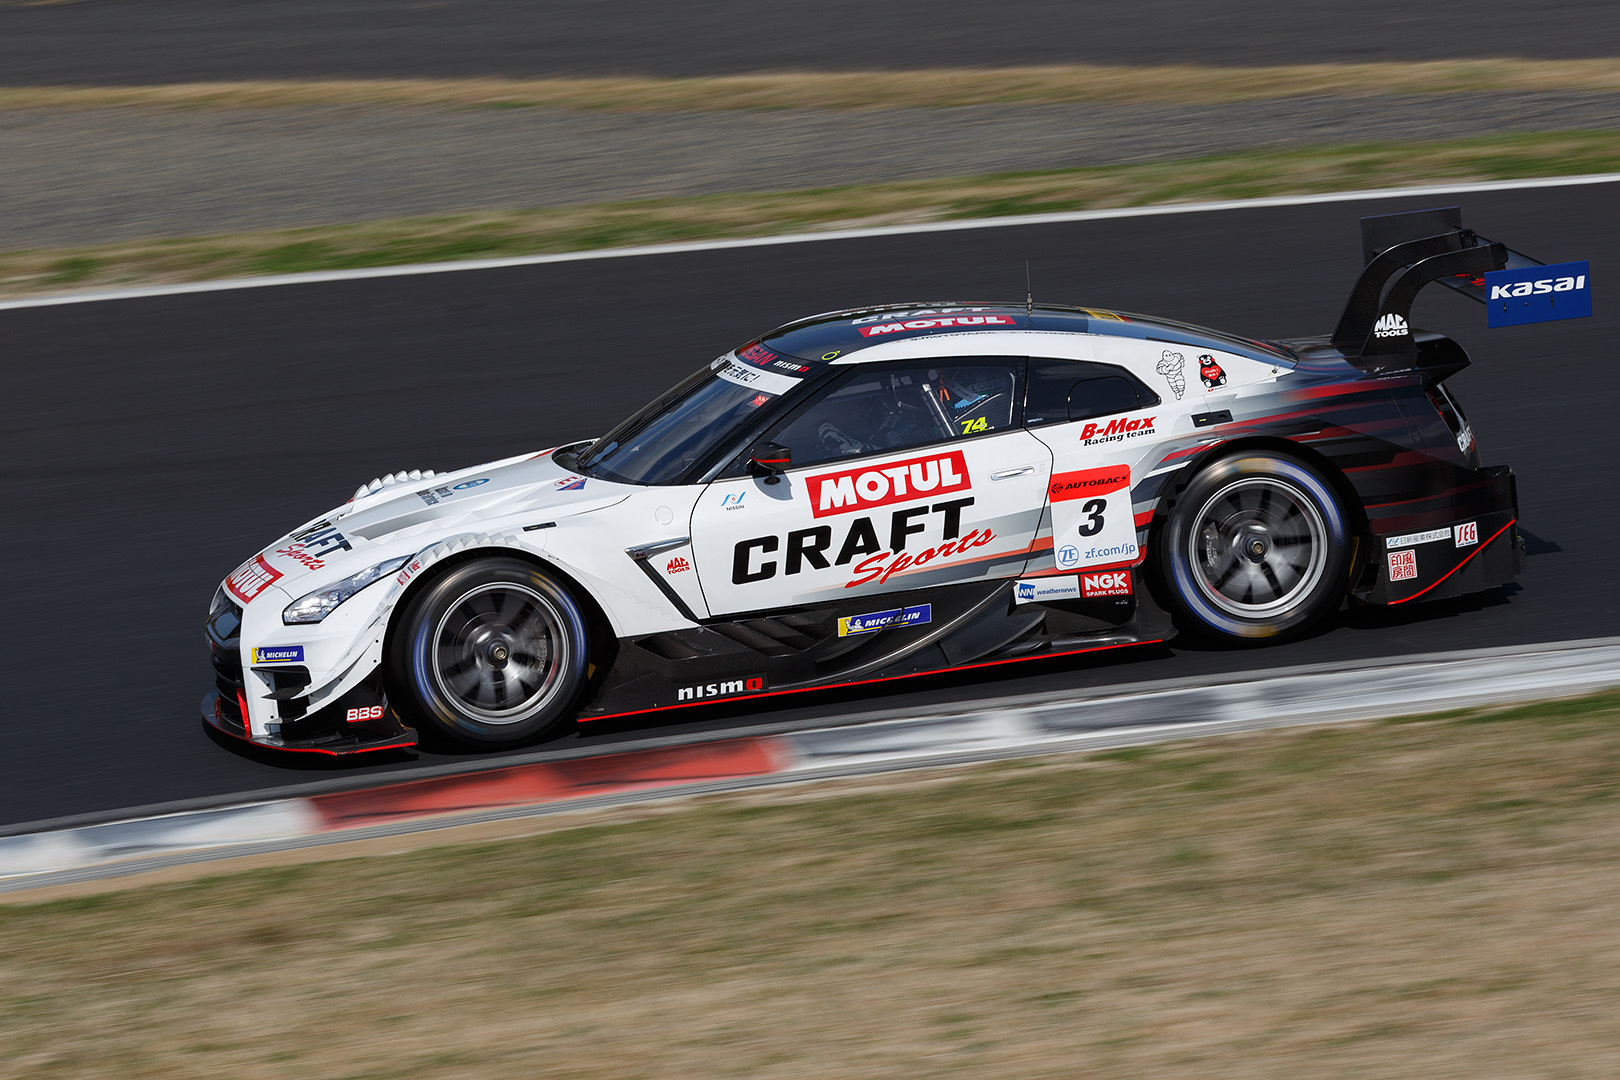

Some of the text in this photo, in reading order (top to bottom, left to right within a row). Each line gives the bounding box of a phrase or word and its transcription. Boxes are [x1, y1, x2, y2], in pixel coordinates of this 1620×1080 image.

[850, 305, 992, 325] CRAFT
[1374, 313, 1408, 332] MAC
[868, 315, 1006, 336] MOTUL
[1374, 328, 1409, 339] TOOLS
[960, 416, 989, 435] 74
[1079, 415, 1158, 441] B-Max
[1083, 427, 1156, 447] Racing team
[819, 456, 964, 512] MOTUL
[1064, 475, 1128, 491] AUTOBACS
[1078, 498, 1108, 537] 3
[731, 496, 975, 586] CRAFT
[276, 543, 326, 571] Sports
[845, 527, 997, 589] Sports
[1059, 551, 1076, 563] ZF
[1085, 542, 1136, 560] zf.com/jp
[666, 556, 690, 572] MAC
[667, 566, 691, 576] TOOLS
[1036, 586, 1077, 596] weathernews
[1084, 572, 1127, 591] NGK
[1108, 588, 1129, 596] PLUGS
[266, 650, 298, 659] MICHELIN
[347, 705, 384, 722] BBS
